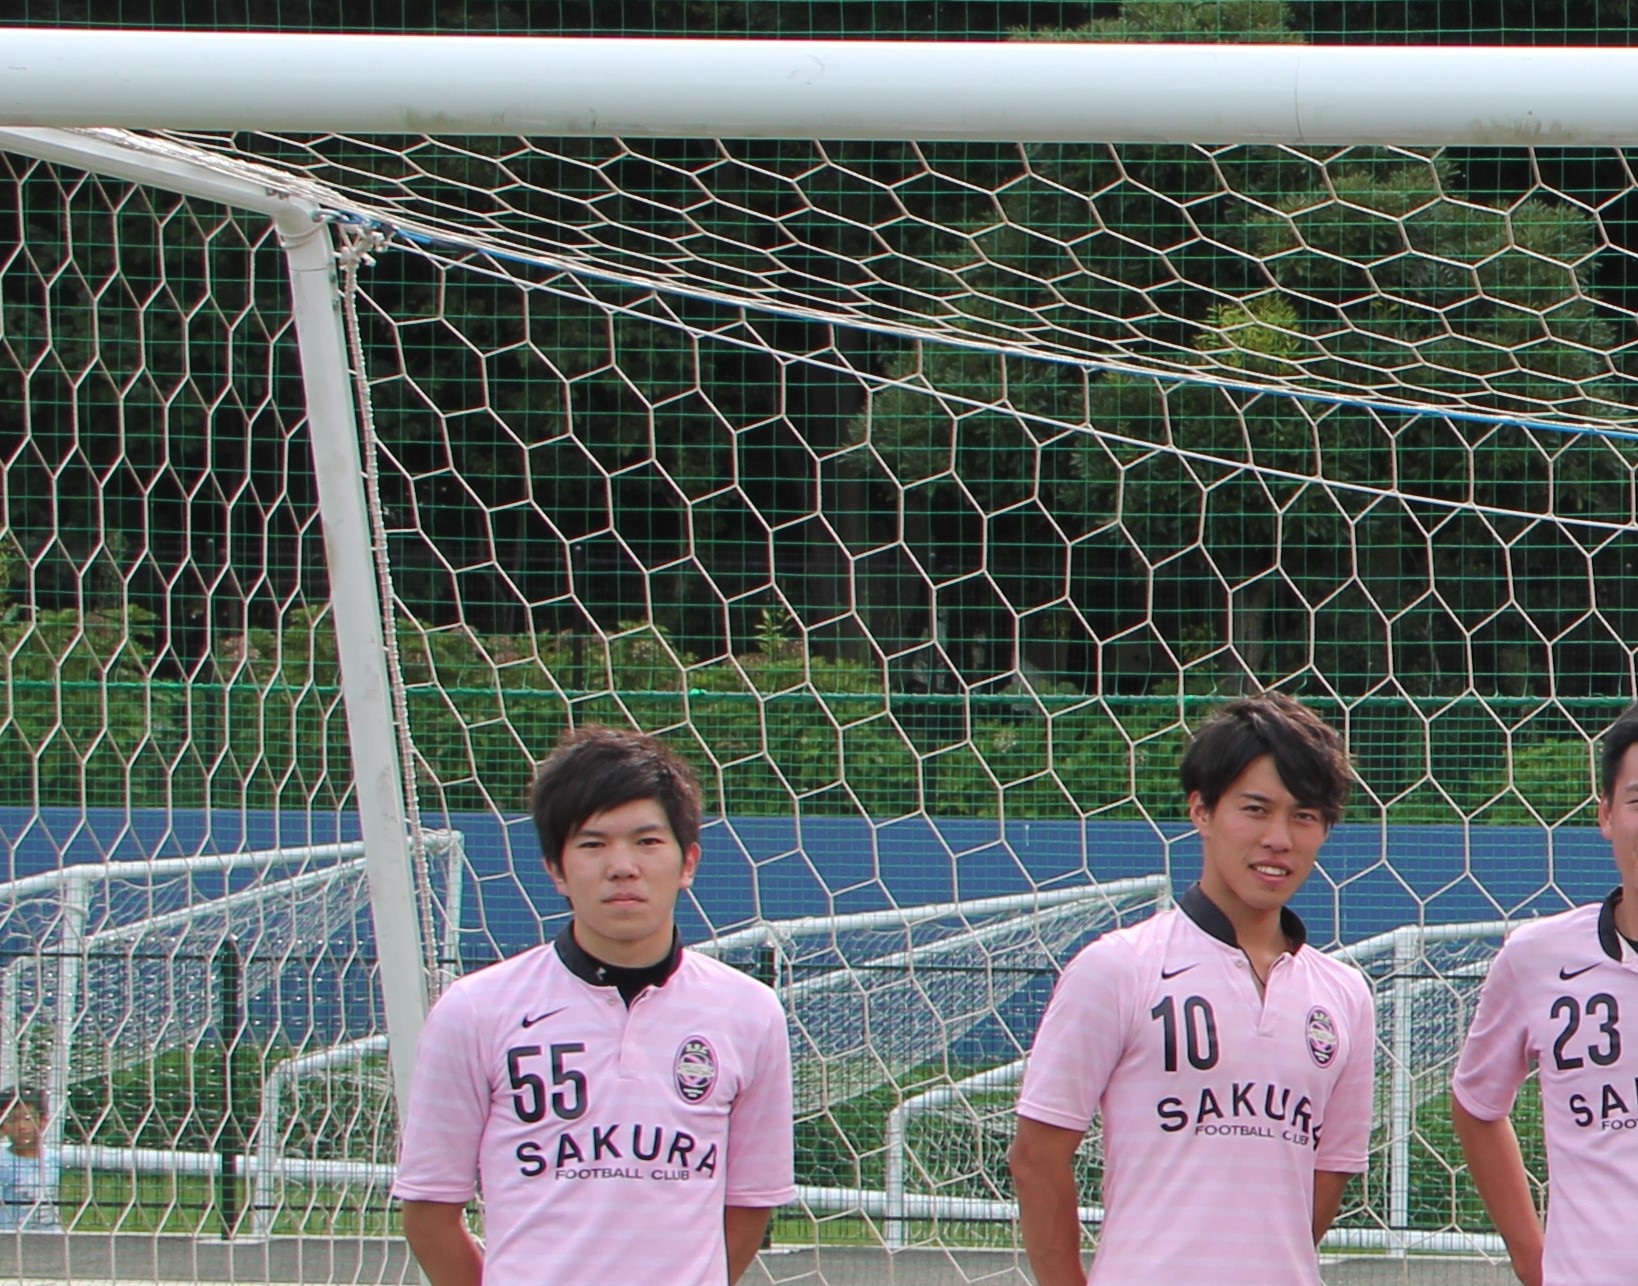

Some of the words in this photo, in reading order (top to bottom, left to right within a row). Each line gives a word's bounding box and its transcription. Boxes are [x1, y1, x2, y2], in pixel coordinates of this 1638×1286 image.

[1151, 995, 1220, 1072] 10
[1550, 993, 1622, 1071] 23
[507, 1044, 588, 1123] 55
[517, 1124, 718, 1179] SAKURA
[1195, 1125, 1275, 1138] FOOTBALL
[555, 1167, 643, 1181] FOOTBALL
[651, 1169, 689, 1181] CLUB
